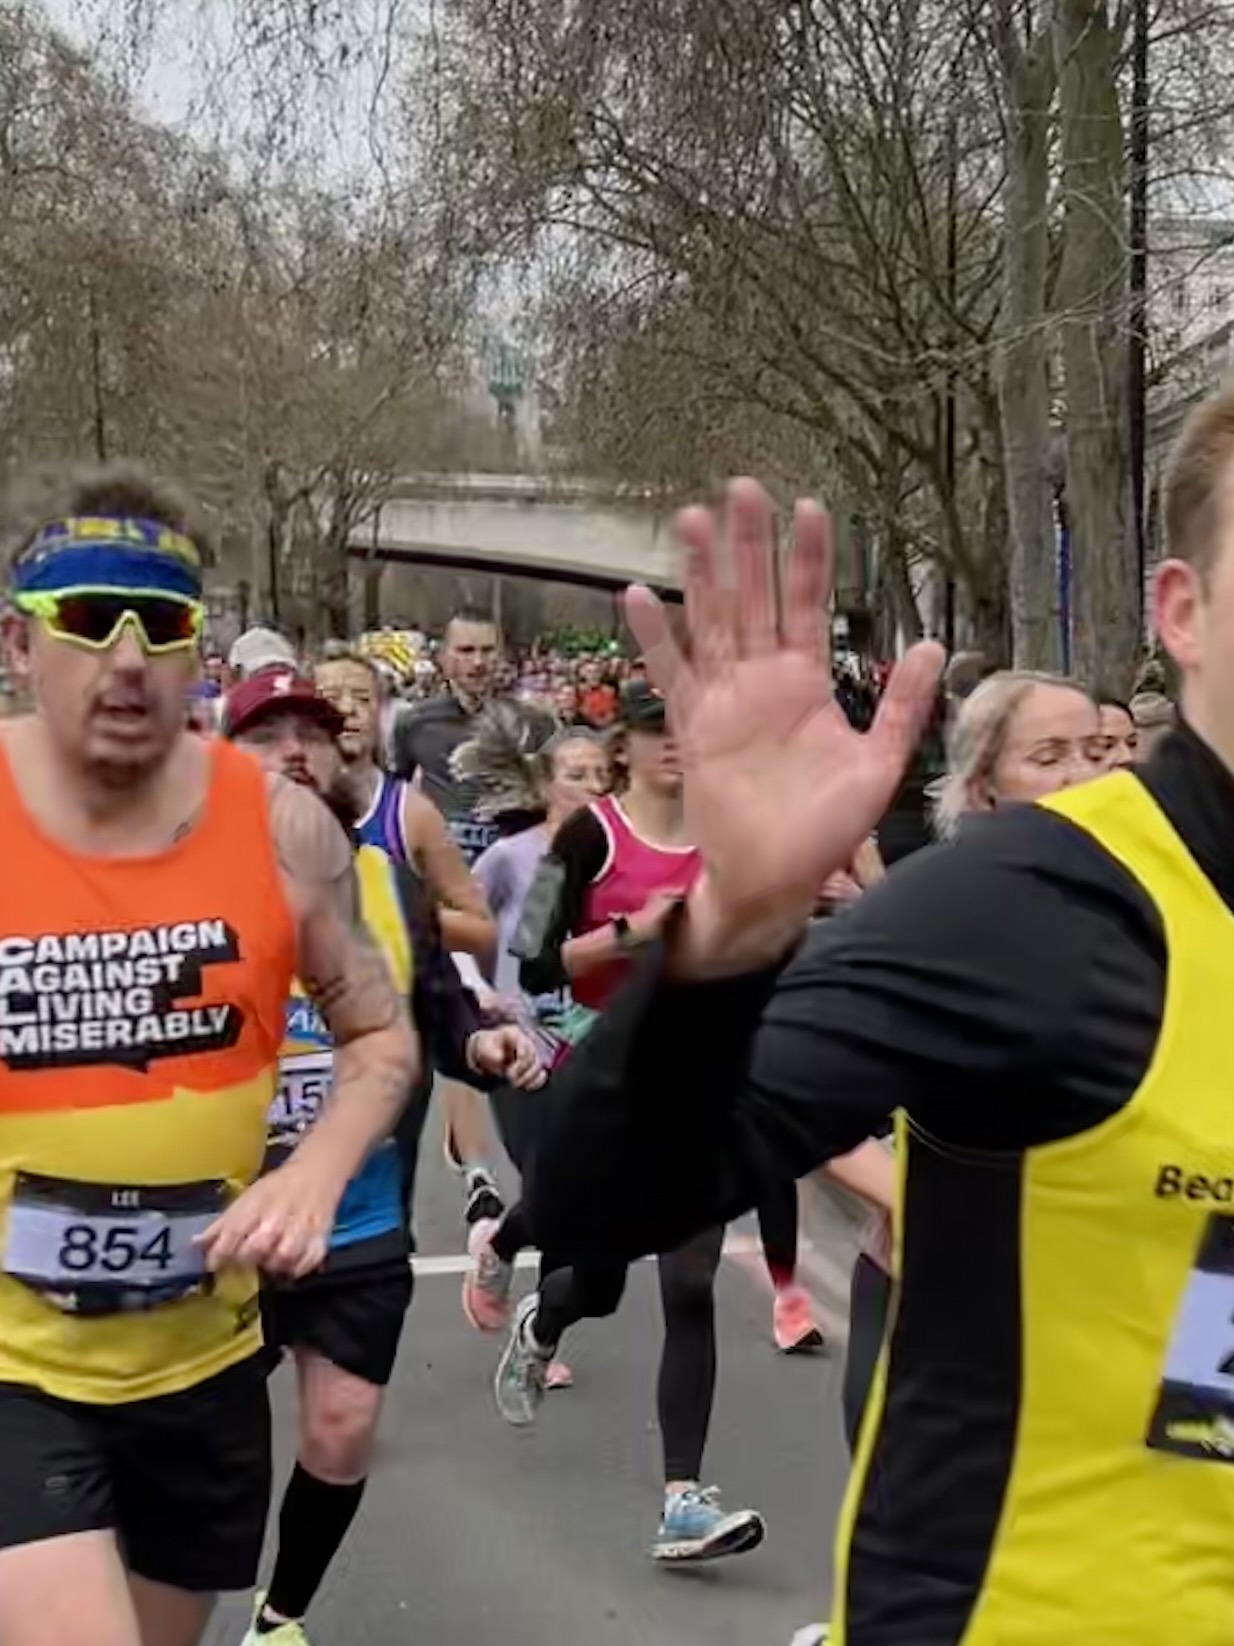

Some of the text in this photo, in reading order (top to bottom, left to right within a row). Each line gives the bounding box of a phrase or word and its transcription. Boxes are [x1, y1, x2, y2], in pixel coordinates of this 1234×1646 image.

[0, 920, 227, 965] CAMPAIGN
[0, 954, 185, 996] AGAINST
[0, 987, 153, 1026] LIVING
[0, 1005, 230, 1056] MISERABLY
[58, 1224, 174, 1272] 854
